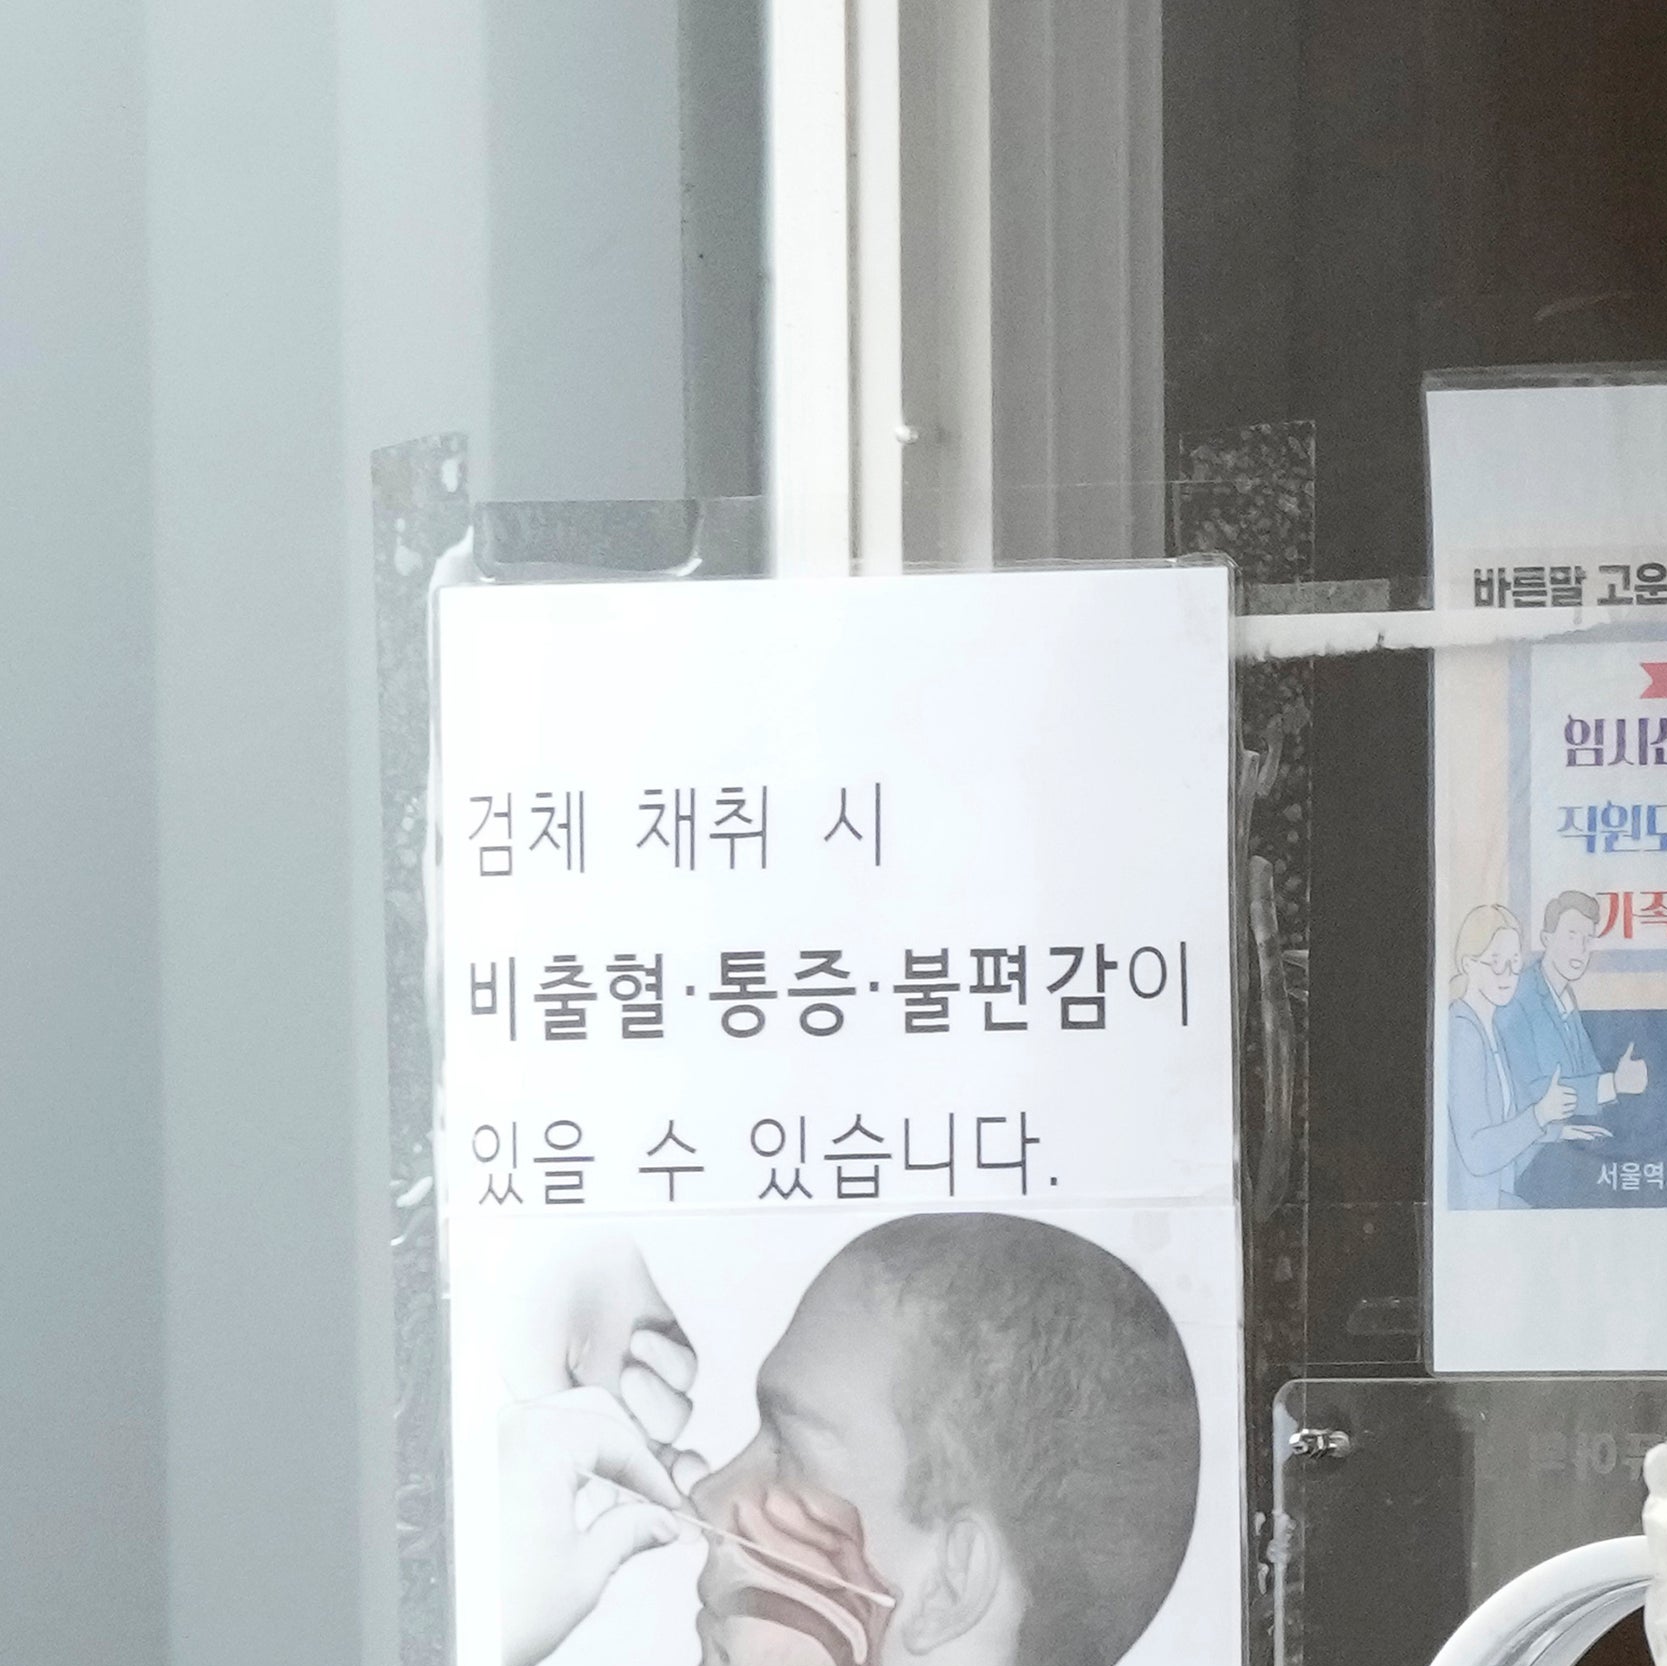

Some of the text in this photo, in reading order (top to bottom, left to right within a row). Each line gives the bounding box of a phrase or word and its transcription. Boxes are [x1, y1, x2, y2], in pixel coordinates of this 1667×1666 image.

[1474, 564, 1587, 609] 바른말
[468, 782, 883, 878] 검체 채취 시
[469, 941, 1189, 1042] 비출혈·통증·불편감이
[472, 1110, 1060, 1206] 있을 수 있습니다.
[1596, 1161, 1666, 1191] 서울역
